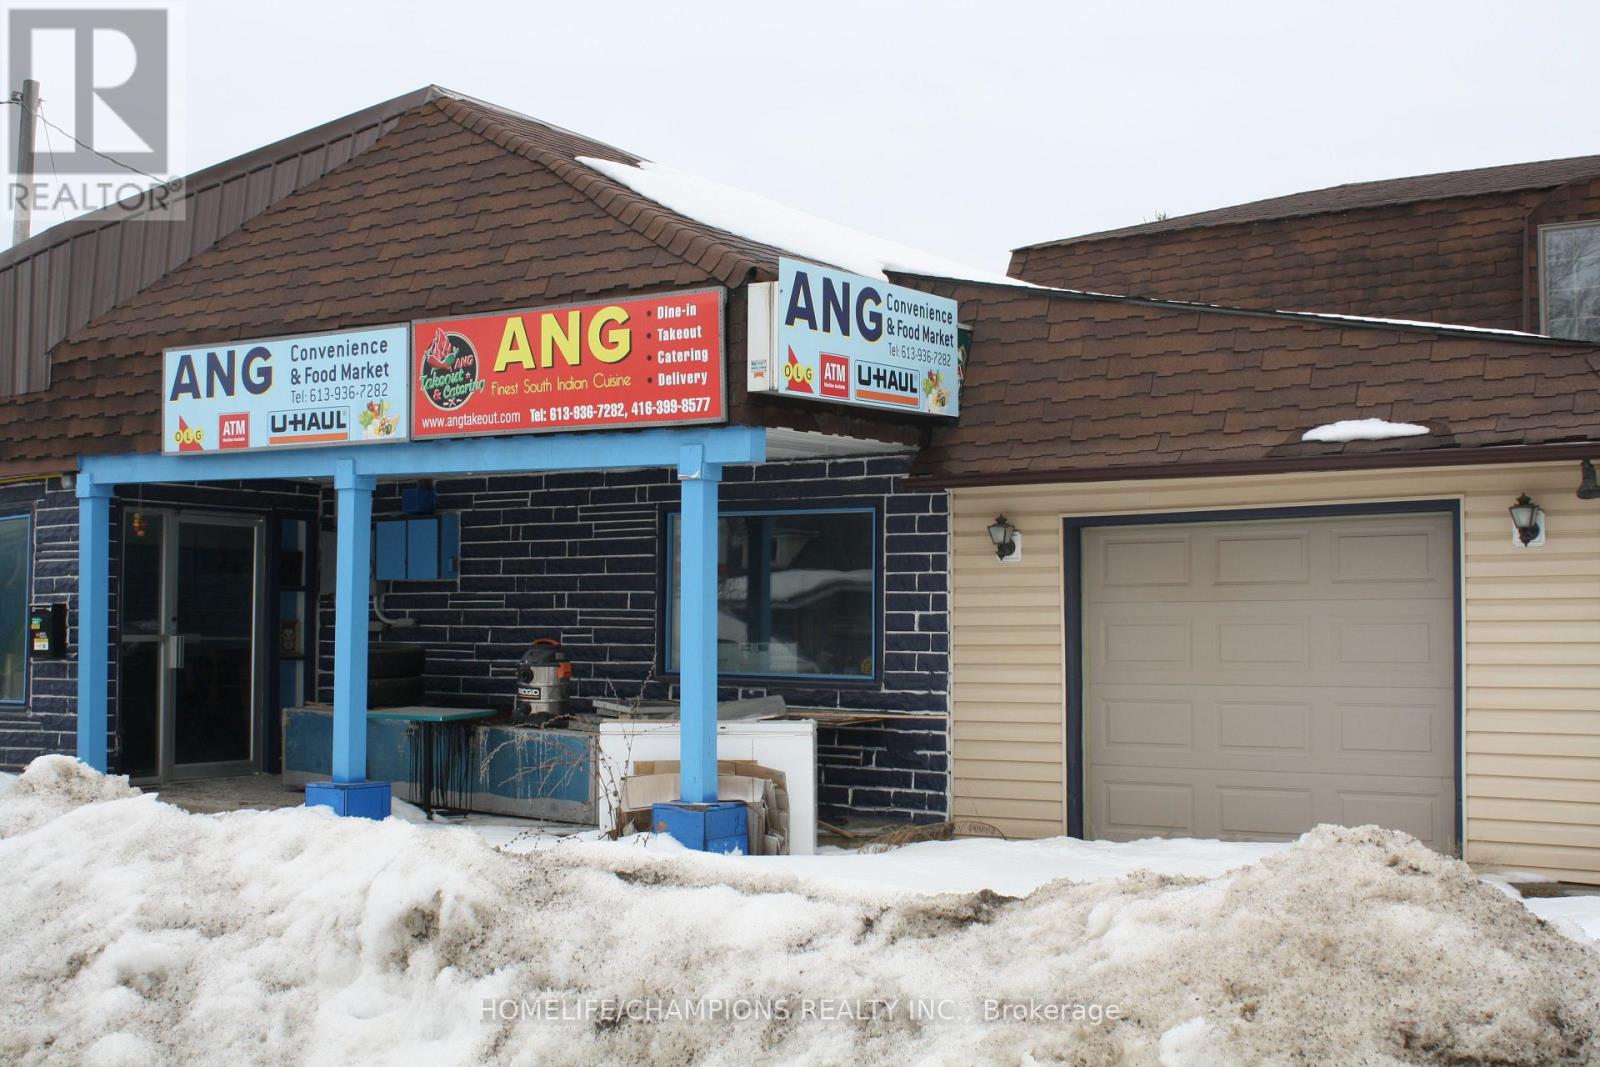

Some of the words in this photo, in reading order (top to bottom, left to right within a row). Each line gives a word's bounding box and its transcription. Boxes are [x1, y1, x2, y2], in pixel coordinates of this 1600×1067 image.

[657, 303, 698, 320] Dine-in
[785, 271, 883, 342] ANG
[886, 293, 953, 325] Convenience
[493, 306, 632, 372] ANG
[657, 325, 703, 342] Takeout
[886, 317, 895, 336] &
[897, 319, 920, 341] Food
[922, 325, 954, 348] Market
[290, 339, 388, 362] Convenience
[454, 354, 474, 370] ANG
[657, 347, 709, 364] Catering
[901, 345, 951, 367] 613-936-7282
[169, 346, 273, 402] ANG
[290, 367, 301, 385] &
[304, 364, 337, 385] Food
[341, 361, 389, 381] Market
[420, 367, 465, 391] Takeout
[658, 371, 708, 386] Delivery
[824, 362, 846, 383] ATM
[857, 364, 918, 394] U-HAUL
[290, 389, 308, 404] Tel:
[309, 382, 388, 403] 613-936-7282
[442, 379, 486, 400] Catering
[491, 380, 519, 397] Finest
[523, 378, 553, 394] South
[557, 376, 589, 391] Indian
[593, 372, 632, 389] Cuisine
[271, 410, 347, 433] U-HAUL
[422, 411, 521, 429] www.angtakeout.com
[530, 407, 547, 423] Tel:
[549, 402, 628, 422] 613-936-7282,
[631, 397, 711, 417] 416-399-8577
[223, 420, 246, 436] ATM
